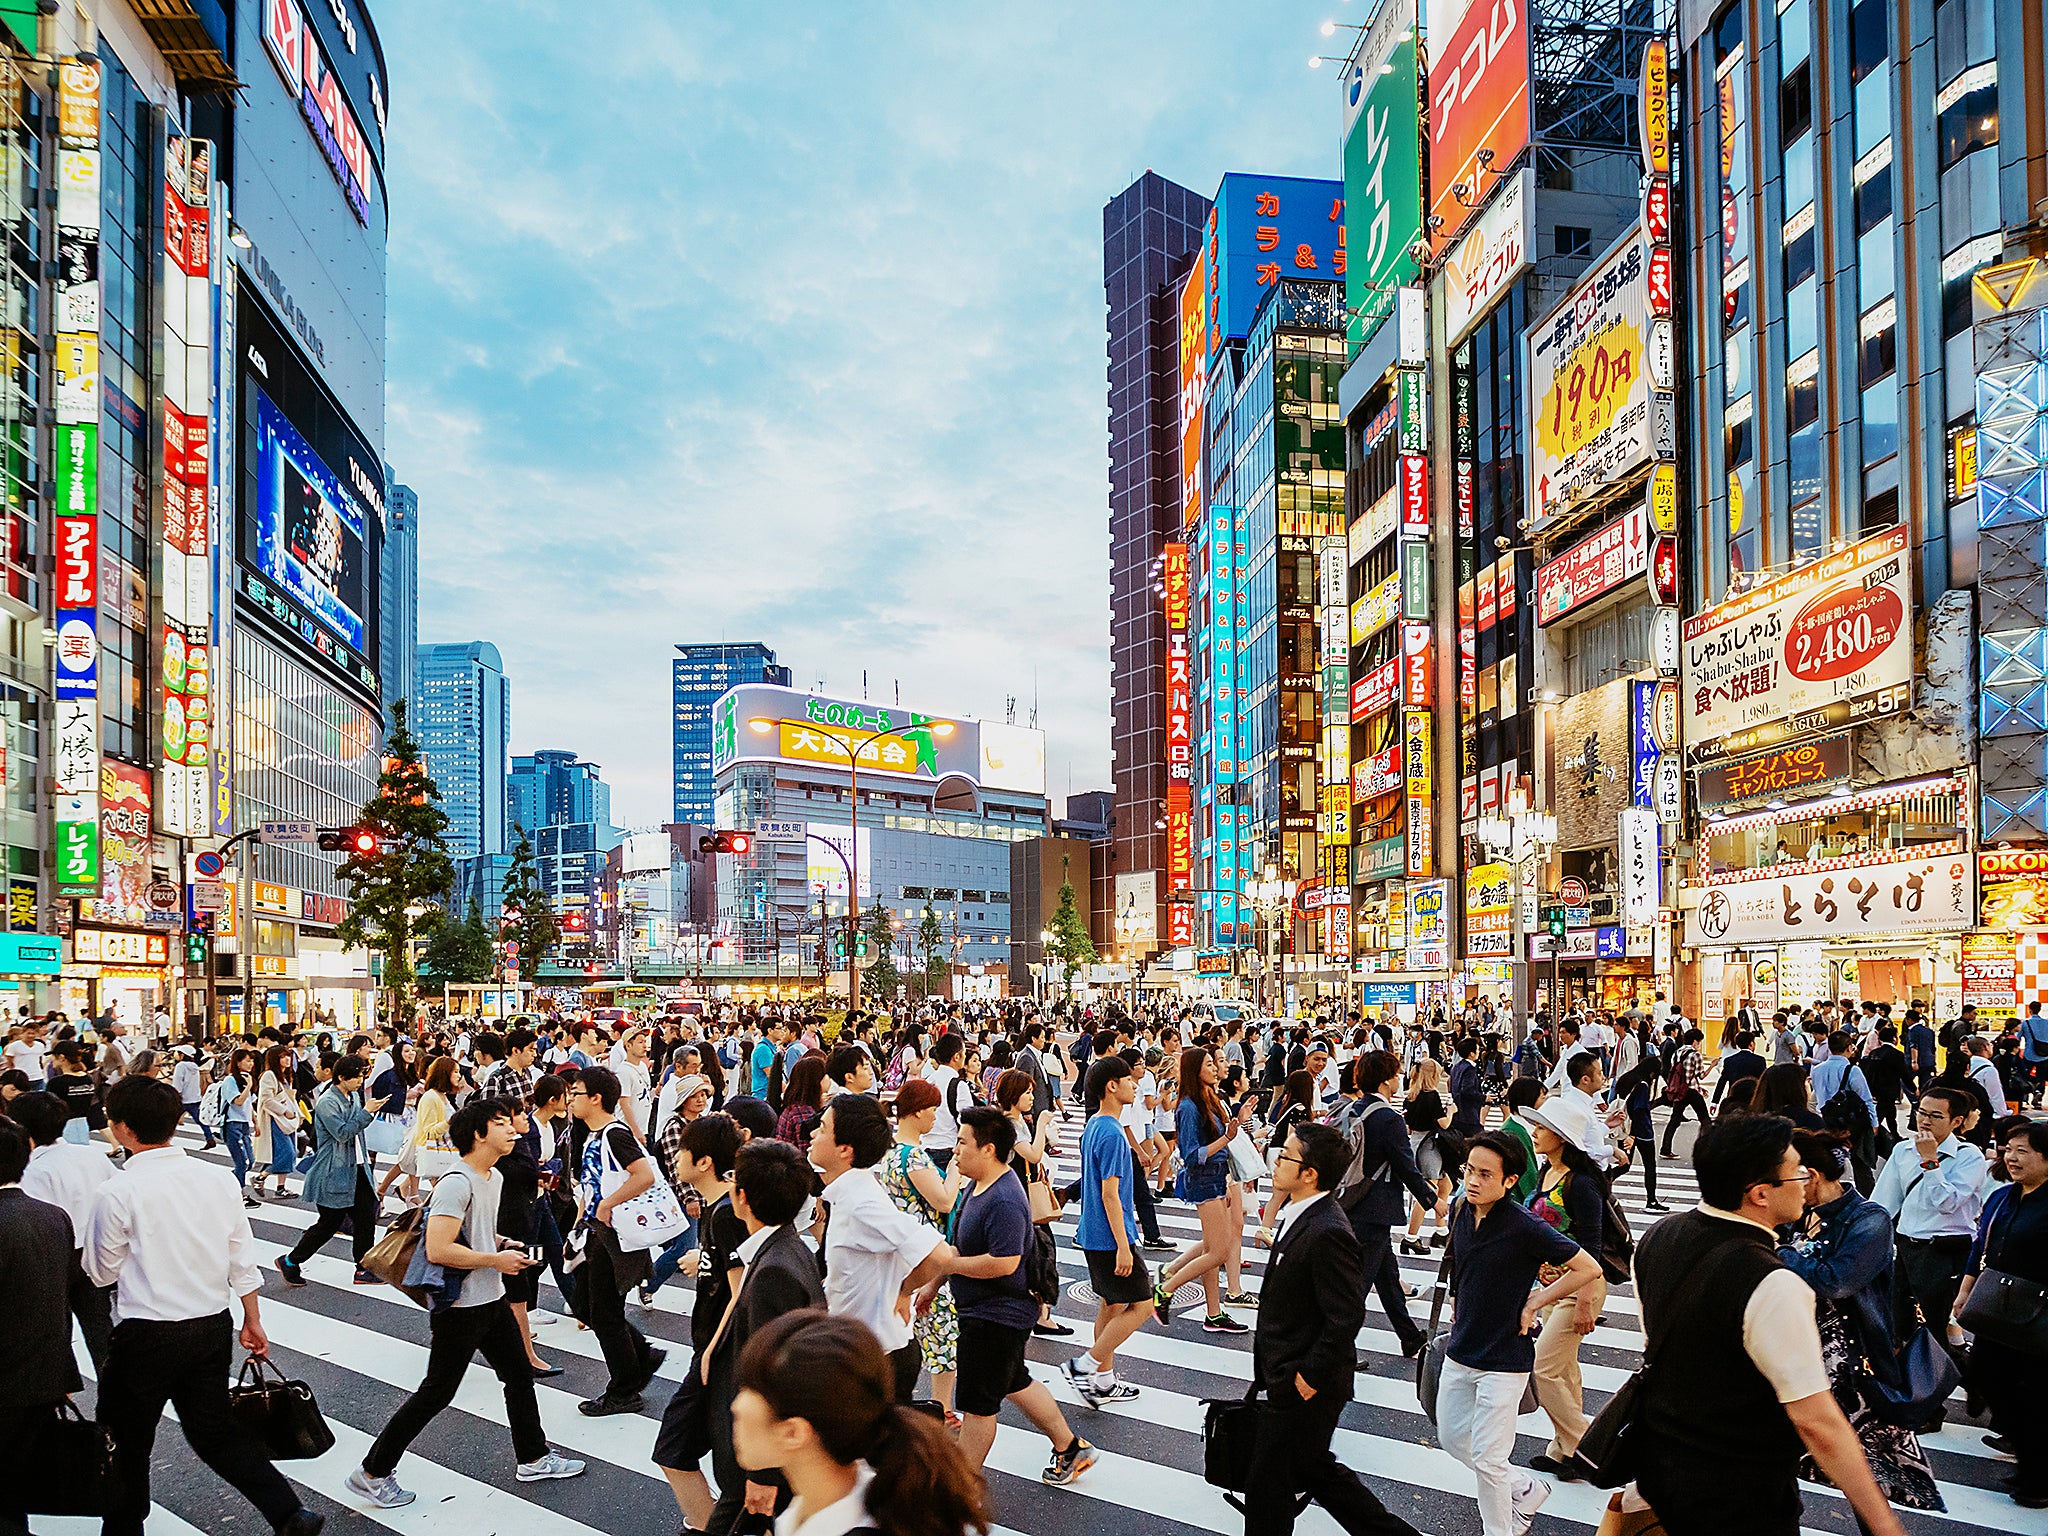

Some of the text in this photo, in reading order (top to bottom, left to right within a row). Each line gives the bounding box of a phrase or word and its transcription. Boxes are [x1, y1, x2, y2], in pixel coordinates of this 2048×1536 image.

[303, 21, 371, 203] LABI
[1365, 104, 1391, 279] レイク
[1505, 185, 1519, 209] 5F
[1255, 191, 1282, 287] カラオ
[1466, 239, 1520, 315] アイフル
[1536, 244, 1642, 357] 一軒め酒場
[1552, 344, 1632, 437] 190円
[1407, 471, 1424, 522] アイフル
[188, 487, 207, 555] まつげ本舗
[63, 520, 92, 602] アイフル
[1628, 550, 1644, 571] 1F
[1775, 571, 1814, 601] buffet
[1843, 554, 1854, 569] 2
[1857, 532, 1904, 562] hours
[1863, 565, 1898, 590] 120分
[1171, 553, 1186, 629] パチンコ
[63, 635, 91, 659] 薬
[1690, 608, 1783, 668] しゃぶしゃぶ
[1410, 656, 1426, 693] アコム
[1662, 668, 1674, 676] 1F
[1694, 660, 1780, 716] 食べ放題!
[806, 698, 893, 733] たのめーる
[1877, 686, 1908, 713] 5F
[1777, 712, 1828, 737] USAGIYA
[61, 705, 95, 787] 大勝軒
[791, 729, 907, 764] 大塚商会
[1408, 736, 1424, 778] 金の蔵
[1412, 781, 1426, 792] 2F
[1663, 767, 1677, 805] かっぱ
[1728, 761, 1827, 799] キャンパスコース
[264, 824, 311, 834] 歌舞伎町
[760, 823, 801, 832] 歌舞伎町
[1172, 811, 1188, 872] パチンコ
[1410, 800, 1421, 870] 東京チカラめし
[1465, 824, 1476, 834] 3F
[66, 826, 88, 875] レイク
[1334, 846, 1348, 886] お好み焼
[1219, 813, 1233, 935] カラオケ館
[1782, 865, 1935, 925] とらそば
[10, 885, 38, 927] 薬
[1735, 897, 1776, 913] 立ちそば
[1368, 984, 1410, 992] SUBNADE
[1707, 999, 1723, 1010] OK!
